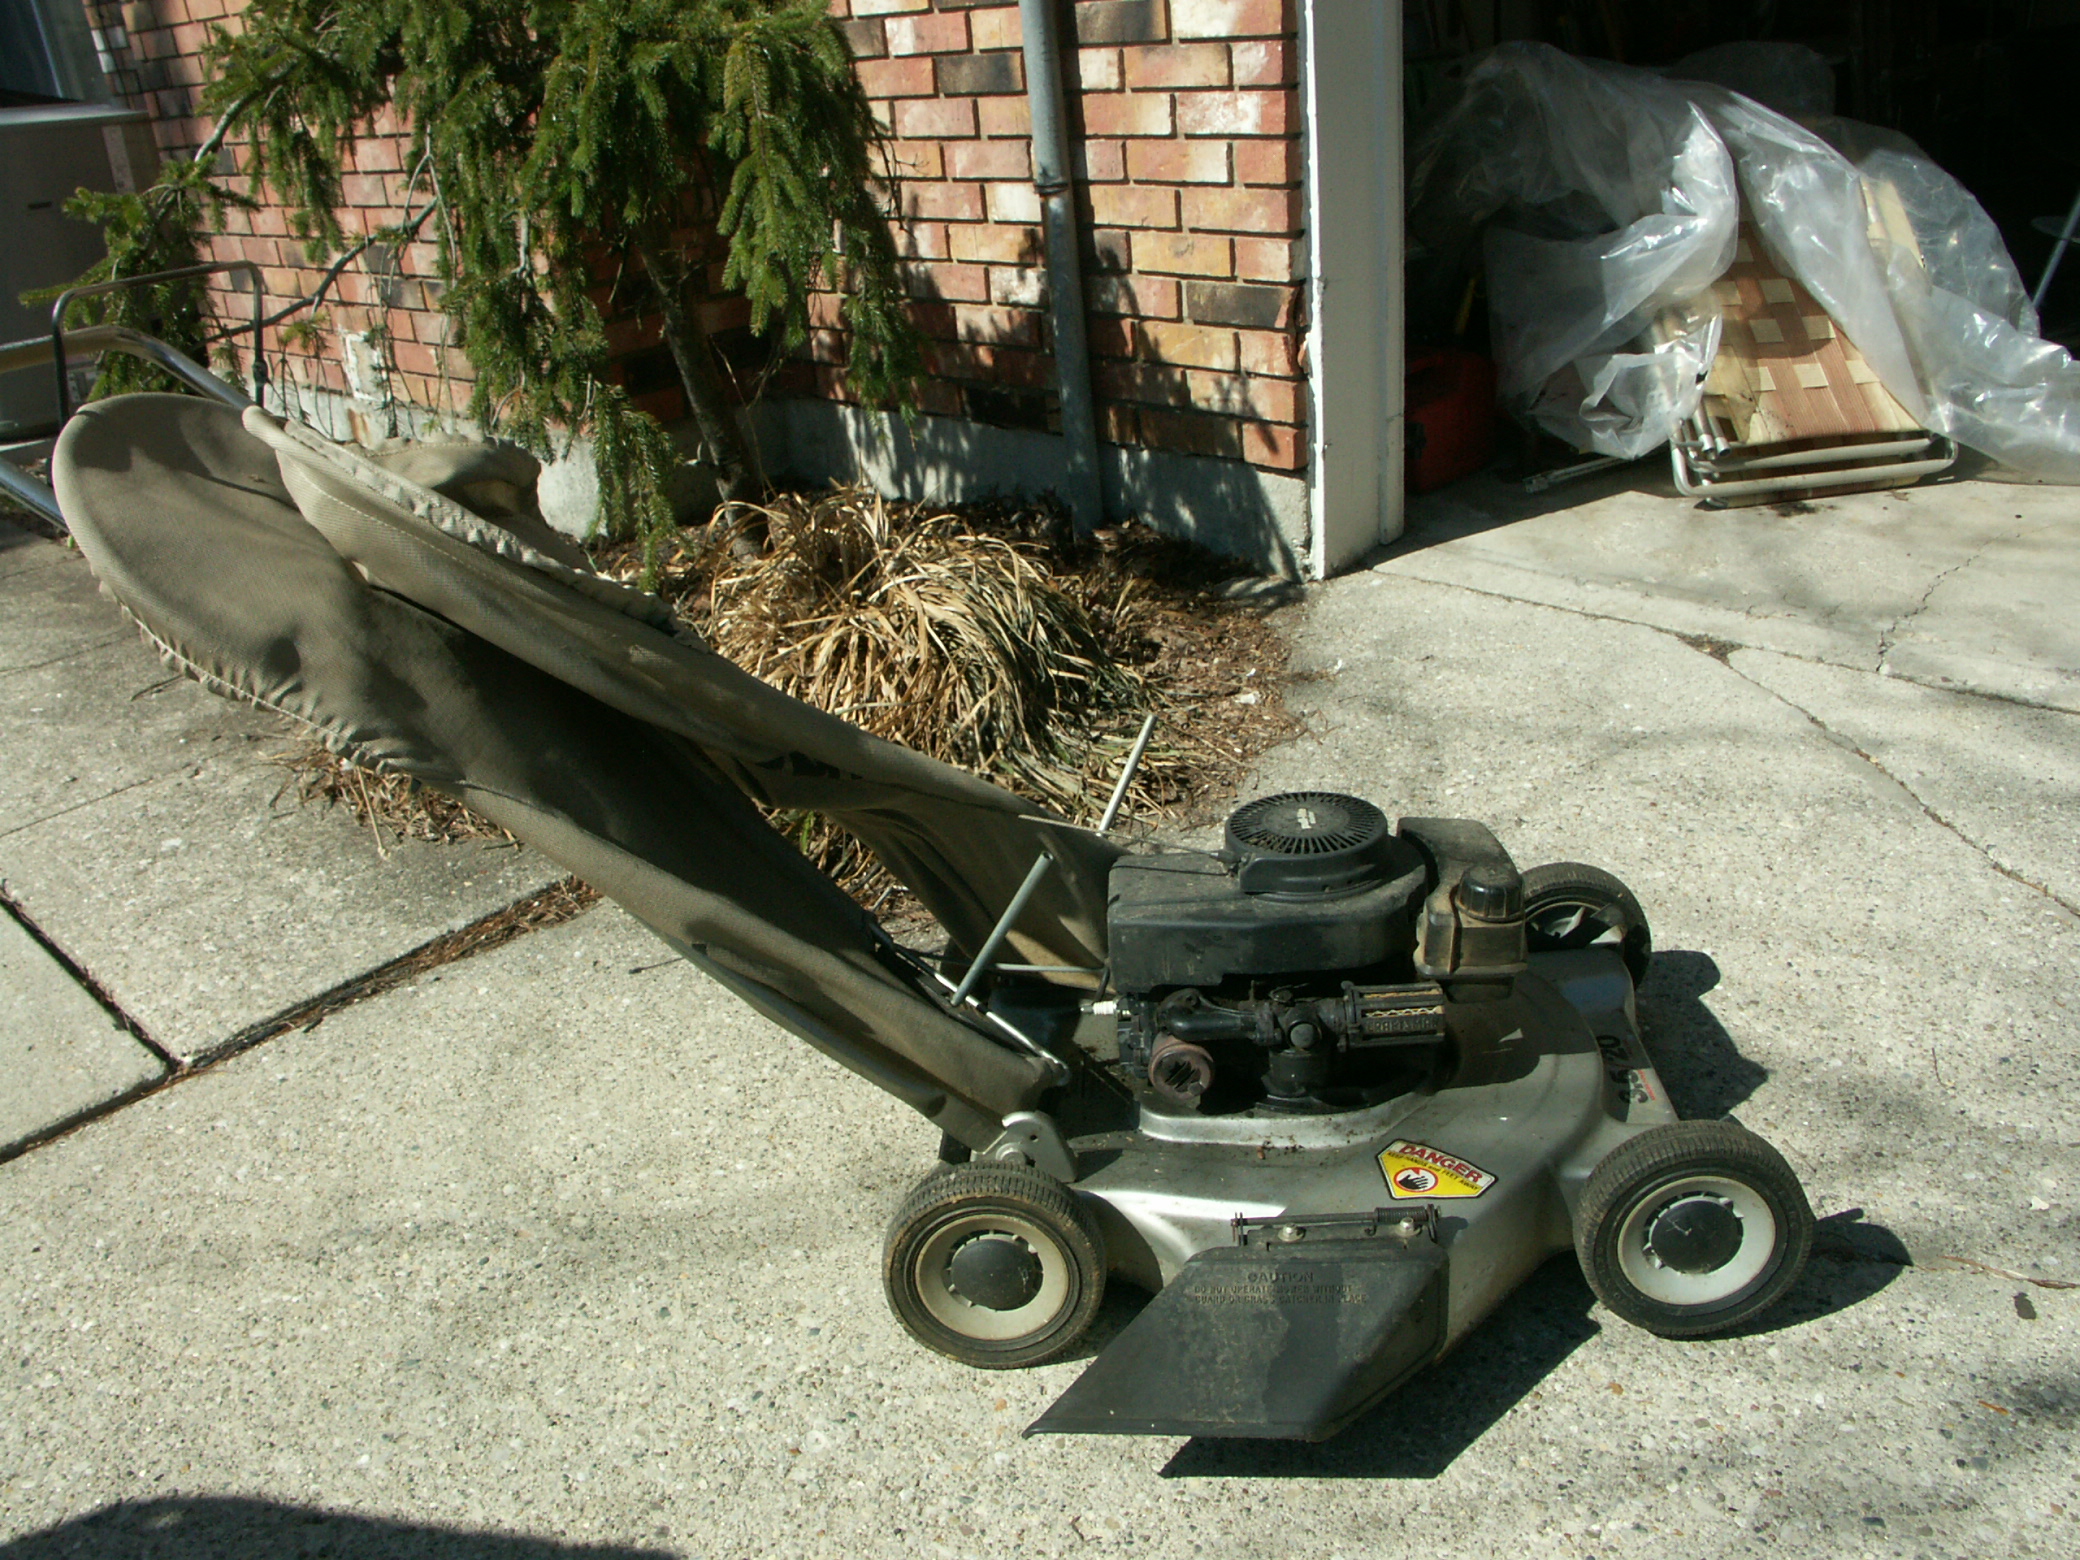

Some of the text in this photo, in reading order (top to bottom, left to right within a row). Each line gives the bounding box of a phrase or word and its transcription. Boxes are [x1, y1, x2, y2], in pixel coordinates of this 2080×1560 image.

[1400, 1144, 1483, 1183] DANGER
[1406, 1156, 1428, 1167] HANDS
[1443, 1169, 1459, 1180] FEET
[1460, 1179, 1478, 1190] AWAY
[1247, 1272, 1314, 1283] CAUTION
[1194, 1285, 1207, 1294] DO
[1209, 1285, 1227, 1294] NOT
